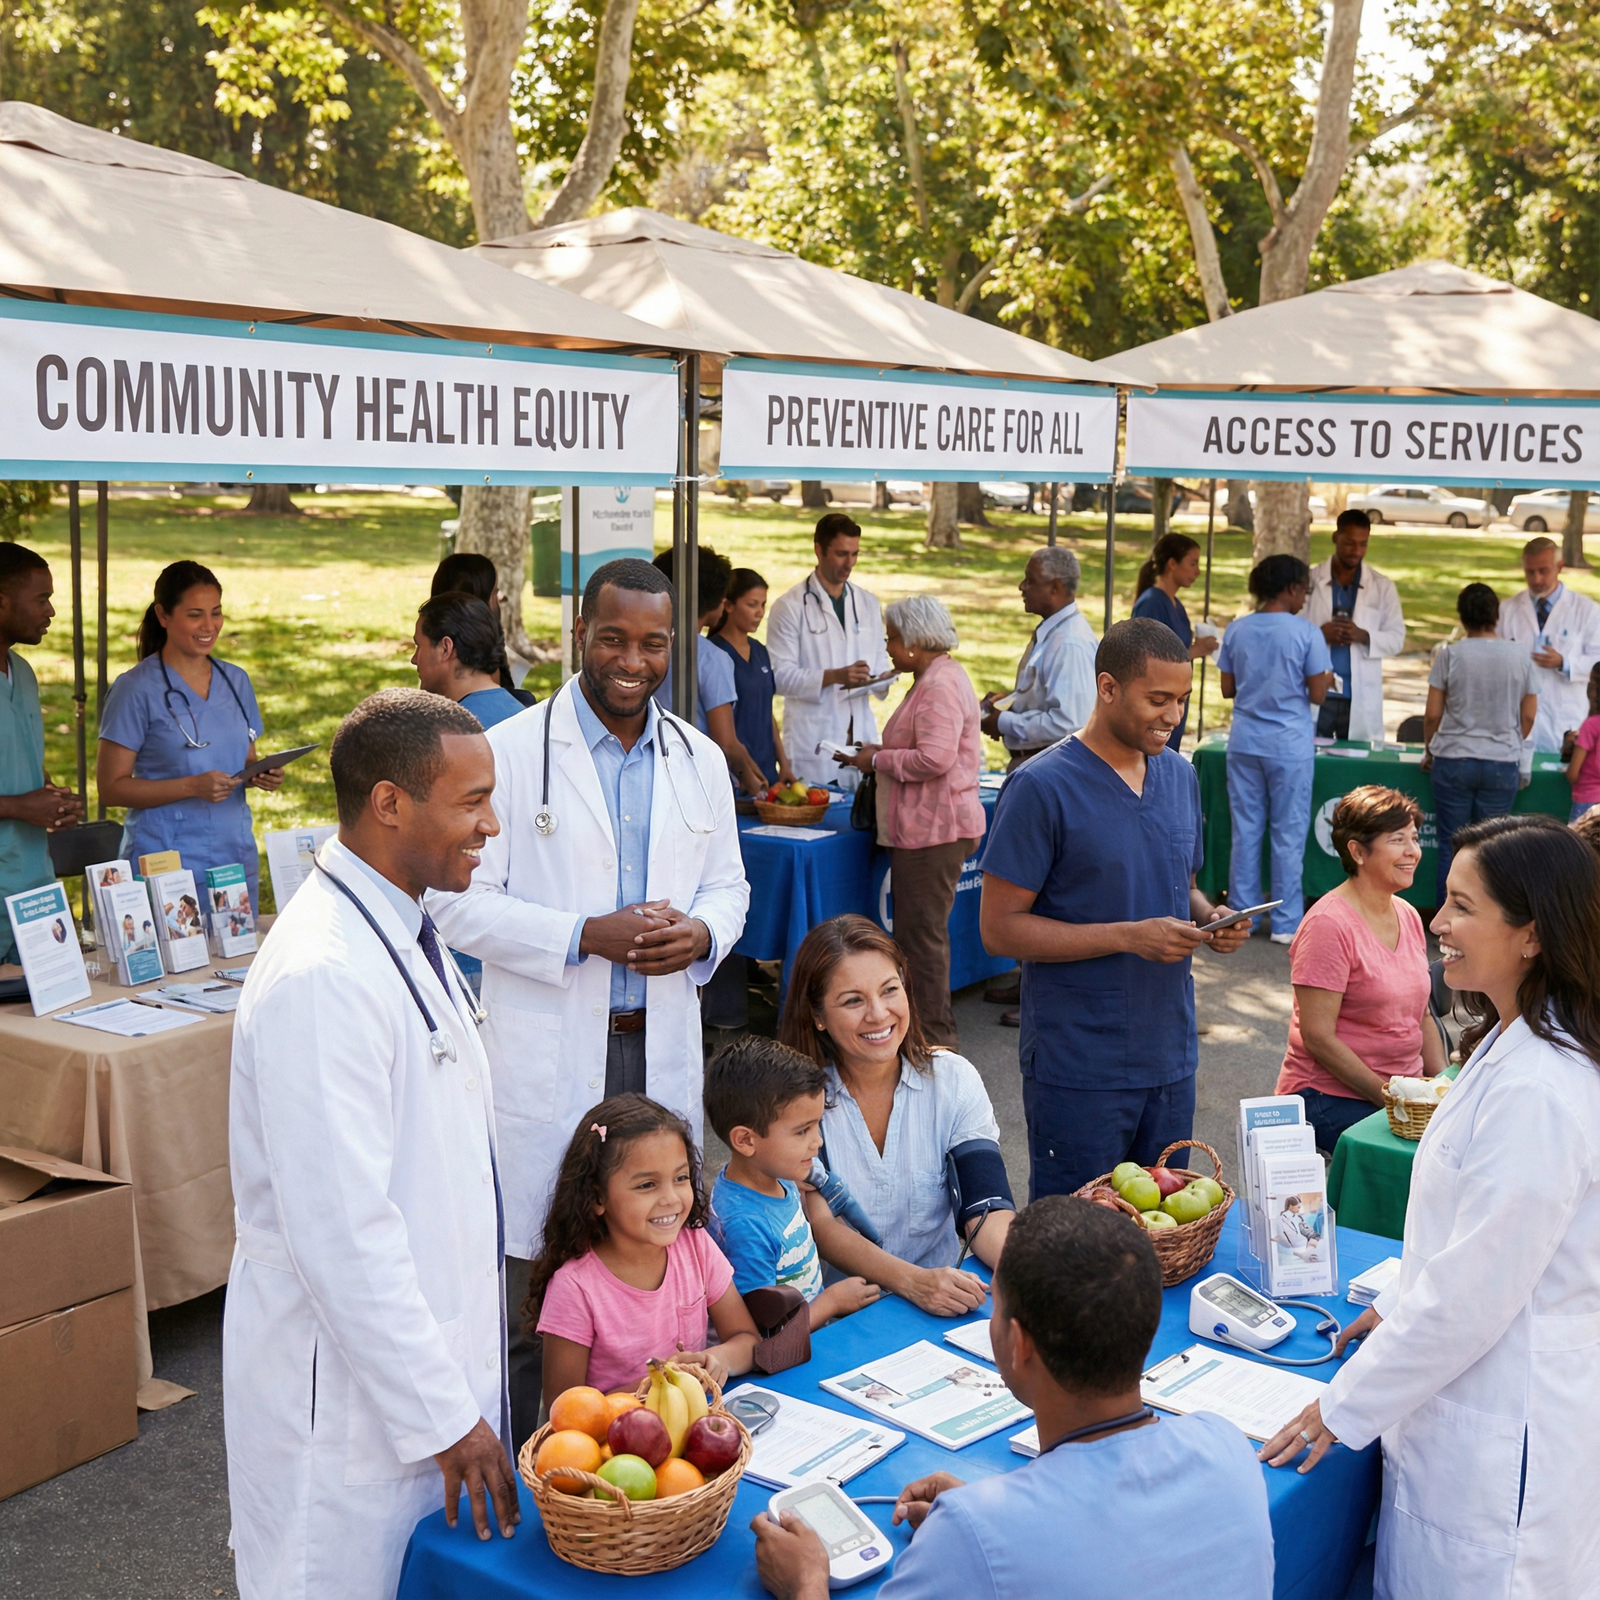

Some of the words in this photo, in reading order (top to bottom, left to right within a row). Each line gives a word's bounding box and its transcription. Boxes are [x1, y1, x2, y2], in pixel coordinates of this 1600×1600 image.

[36, 354, 341, 440] COMMUNITY
[356, 375, 499, 446] HEALTH
[513, 386, 631, 452] EQUITY
[767, 394, 928, 451] PREVENTIVE
[937, 404, 996, 453] CARE
[1003, 408, 1044, 454] FOR
[1049, 411, 1084, 455] ALL
[1202, 416, 1337, 458] ACCESS
[1350, 419, 1392, 459] TO
[1404, 420, 1584, 464] SERVICES
